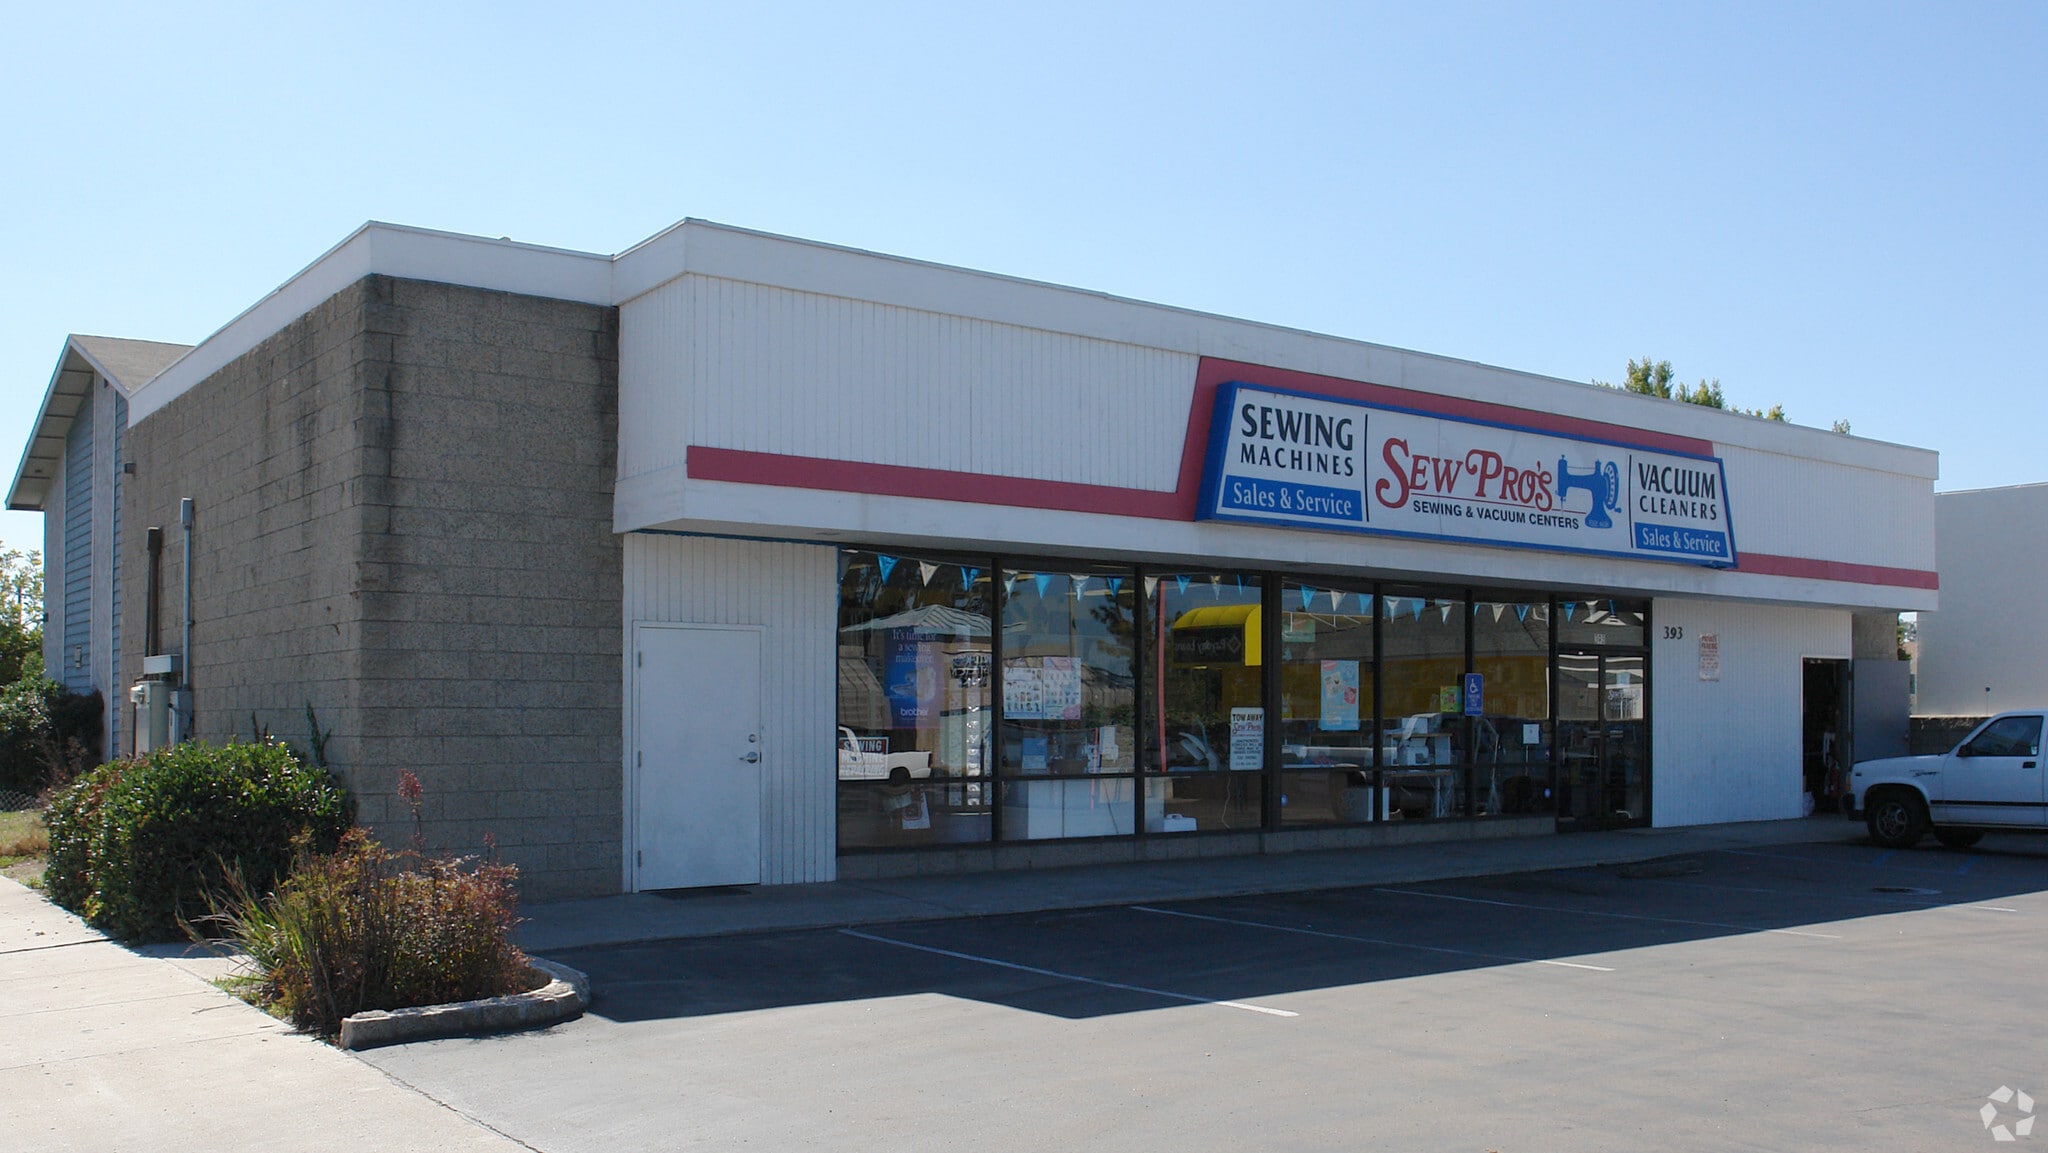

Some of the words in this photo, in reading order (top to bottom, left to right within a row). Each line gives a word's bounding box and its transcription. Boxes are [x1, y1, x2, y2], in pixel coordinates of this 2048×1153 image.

[1241, 403, 1353, 451] SEWING
[1240, 443, 1354, 477] MACHINES
[1375, 438, 1464, 509] SEW
[1638, 462, 1716, 500] VACUUM
[1233, 482, 1276, 508] Sales
[1280, 487, 1292, 509] &
[1296, 489, 1352, 516] Service
[1639, 495, 1717, 520] CLEANERS
[1413, 500, 1462, 517] SEWING
[1466, 505, 1474, 517] &
[1476, 507, 1526, 523] VACUUM
[1528, 514, 1580, 530] CENTERS
[1642, 527, 1671, 547] Sales
[1673, 530, 1681, 549] &
[1683, 532, 1721, 553] Service
[1663, 626, 1684, 640] 393
[900, 707, 929, 717] brother
[843, 740, 883, 752] SWING
